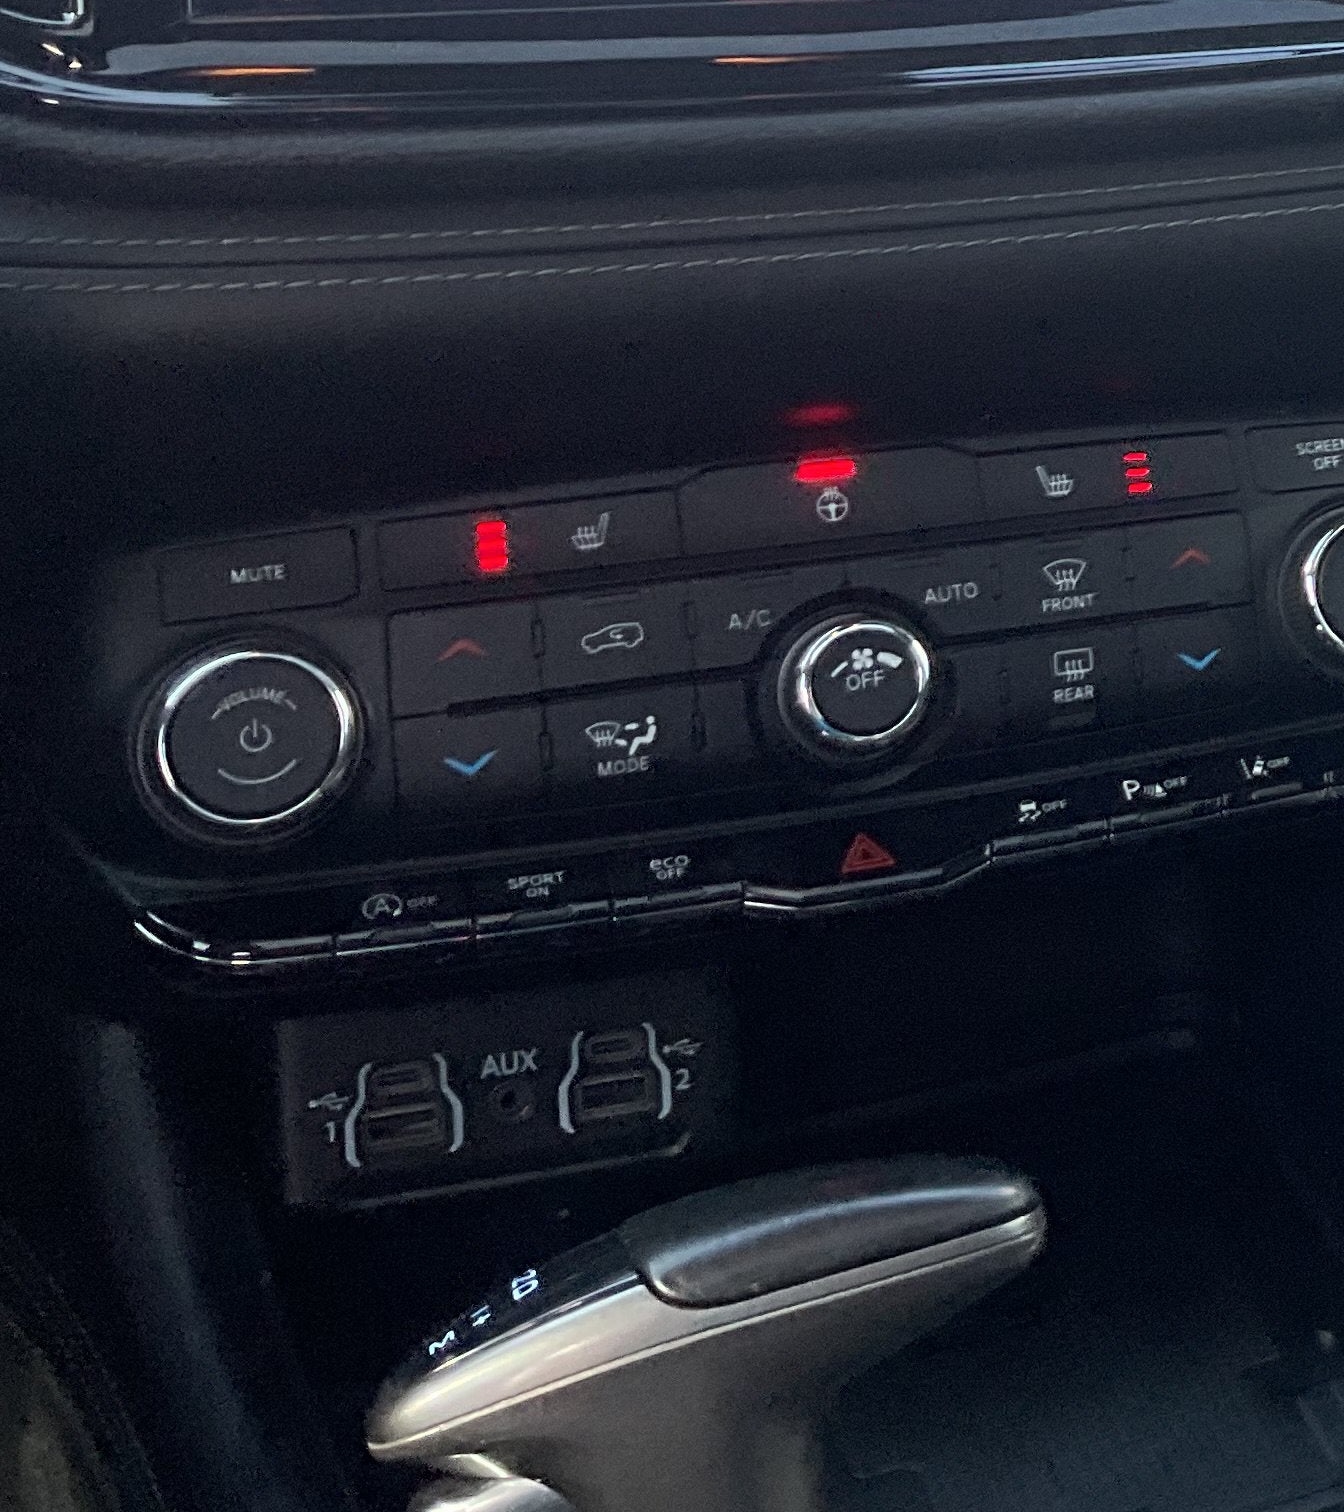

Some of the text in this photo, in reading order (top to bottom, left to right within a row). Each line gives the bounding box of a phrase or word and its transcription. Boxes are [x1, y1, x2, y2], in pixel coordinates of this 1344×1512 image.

[1312, 453, 1342, 472] OFF
[229, 563, 288, 585] MUTE
[924, 581, 979, 606] AUTO
[1041, 592, 1096, 613] FRONT
[728, 608, 773, 631] A/C
[845, 668, 886, 693] OFF
[1053, 685, 1095, 704] REAR
[597, 755, 650, 777] MODE
[508, 870, 568, 890] SPORT
[656, 868, 683, 881] OFF
[526, 887, 551, 899] ON
[480, 1047, 538, 1078] AUX
